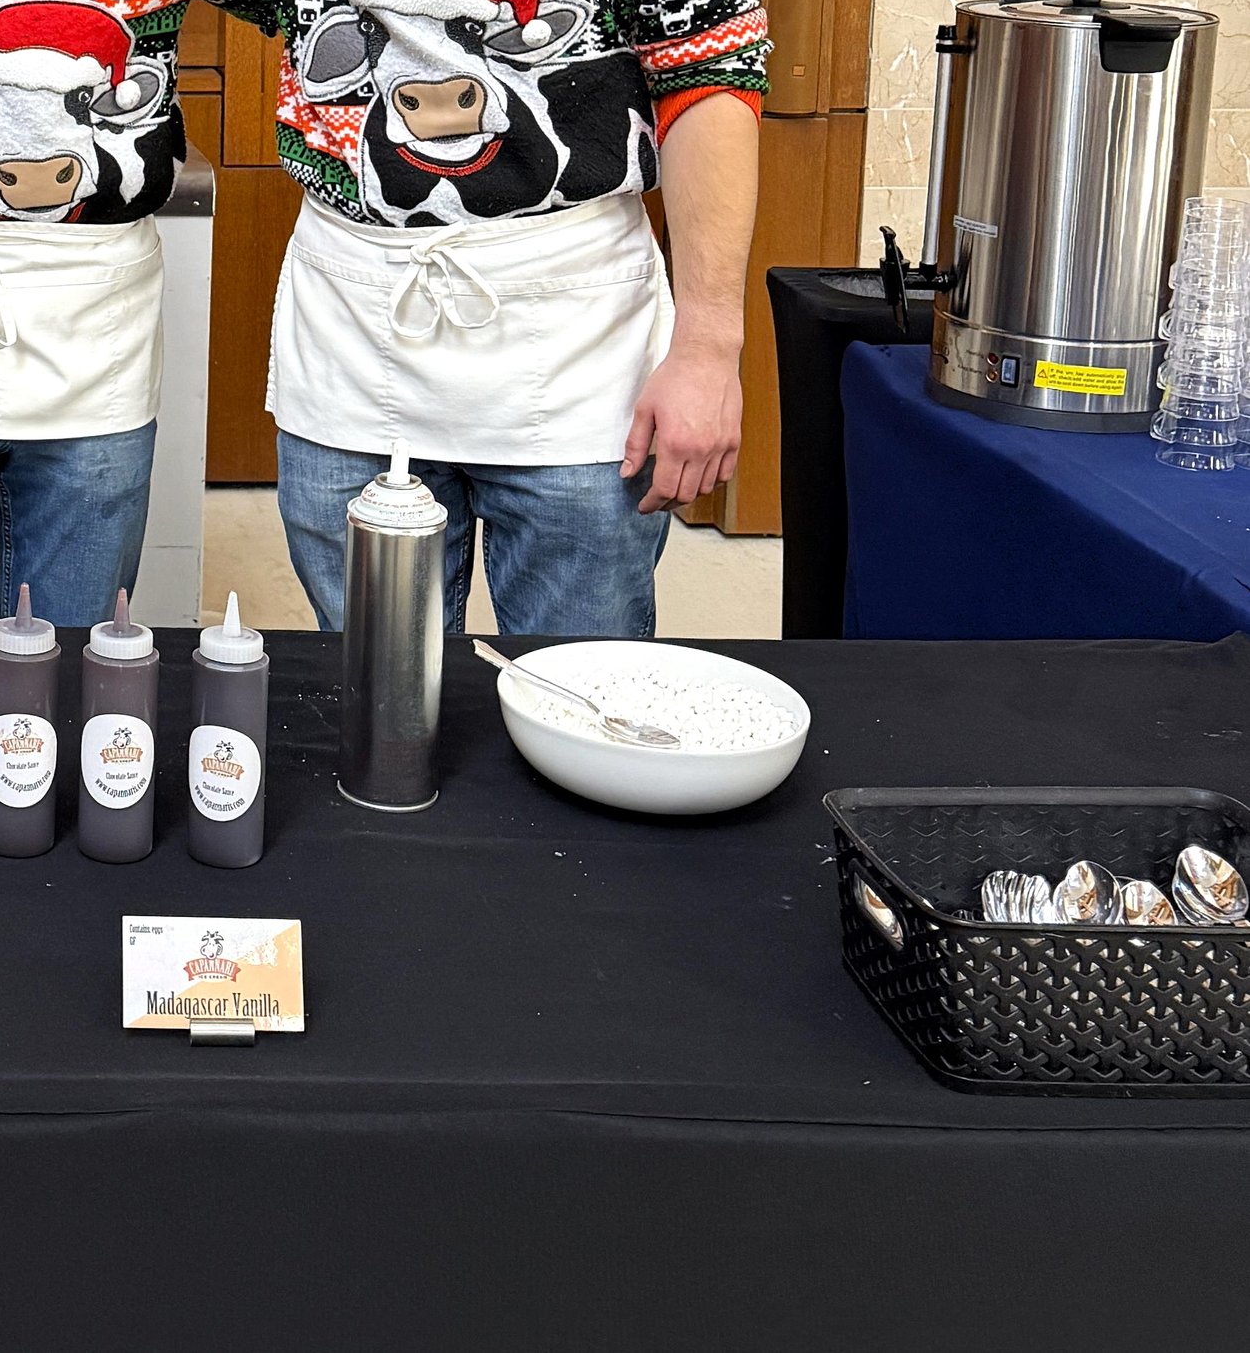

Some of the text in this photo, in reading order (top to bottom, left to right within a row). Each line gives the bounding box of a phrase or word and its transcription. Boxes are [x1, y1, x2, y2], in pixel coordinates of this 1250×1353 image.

[188, 957, 235, 976] CAPANNARI
[146, 990, 280, 1019] Madagascar Vanilla
